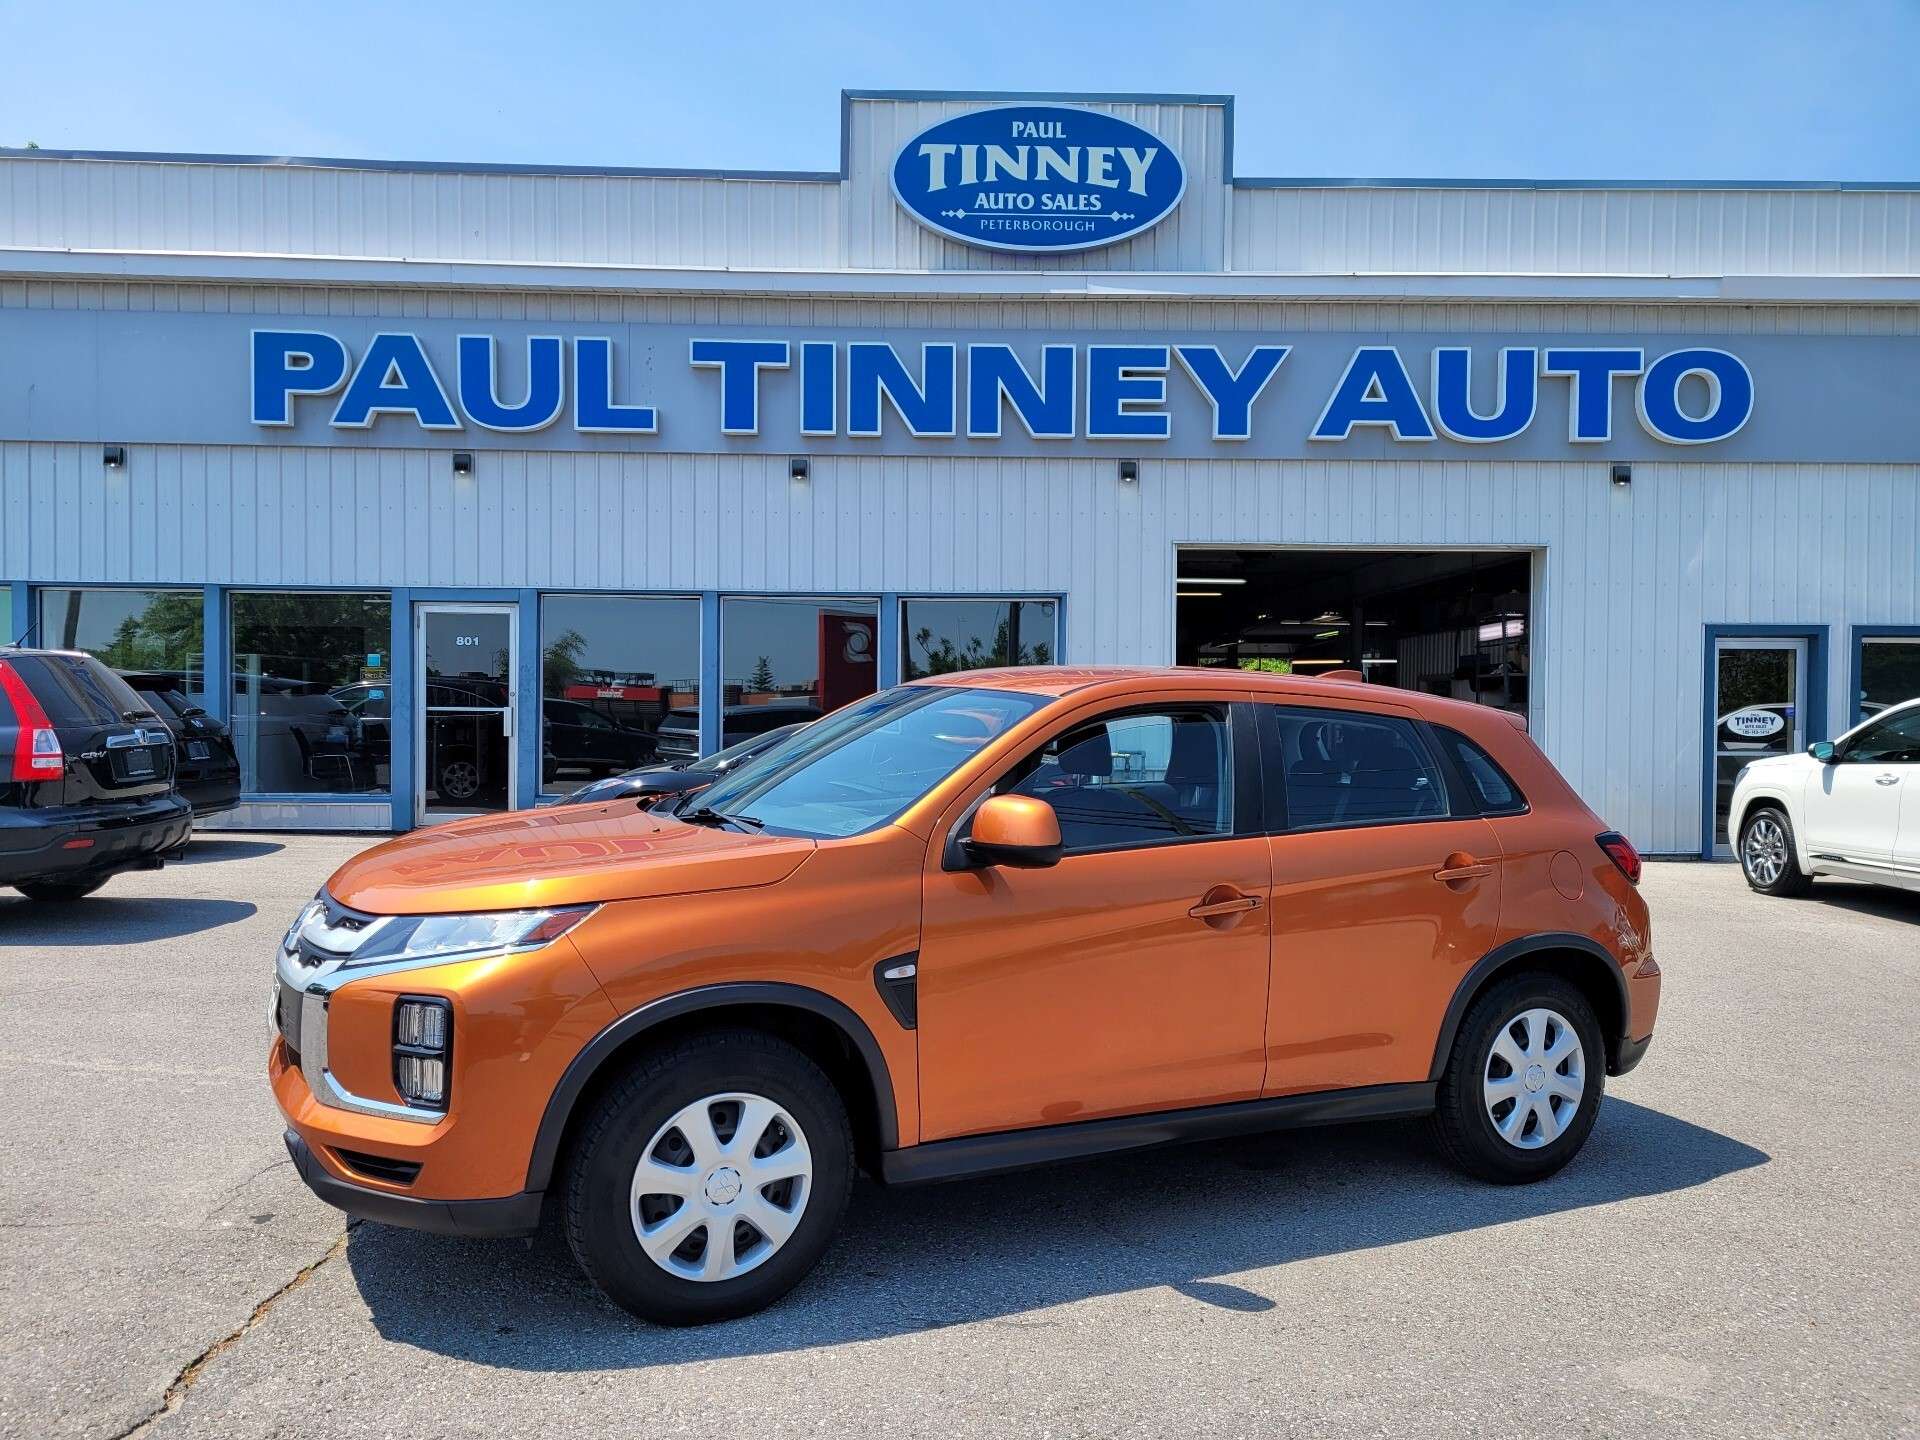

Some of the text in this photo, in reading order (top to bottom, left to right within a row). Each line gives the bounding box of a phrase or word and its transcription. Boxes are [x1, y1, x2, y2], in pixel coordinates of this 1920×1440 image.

[1012, 121, 1067, 139] PAUL
[918, 143, 1158, 197] TINNEY
[974, 193, 1101, 211] AUTO SALES
[980, 219, 1095, 232] PETERBOROUGH
[250, 328, 1755, 445] PAUL TINNEY AUTO
[456, 636, 479, 646] 801
[1735, 716, 1776, 726] TINNEY
